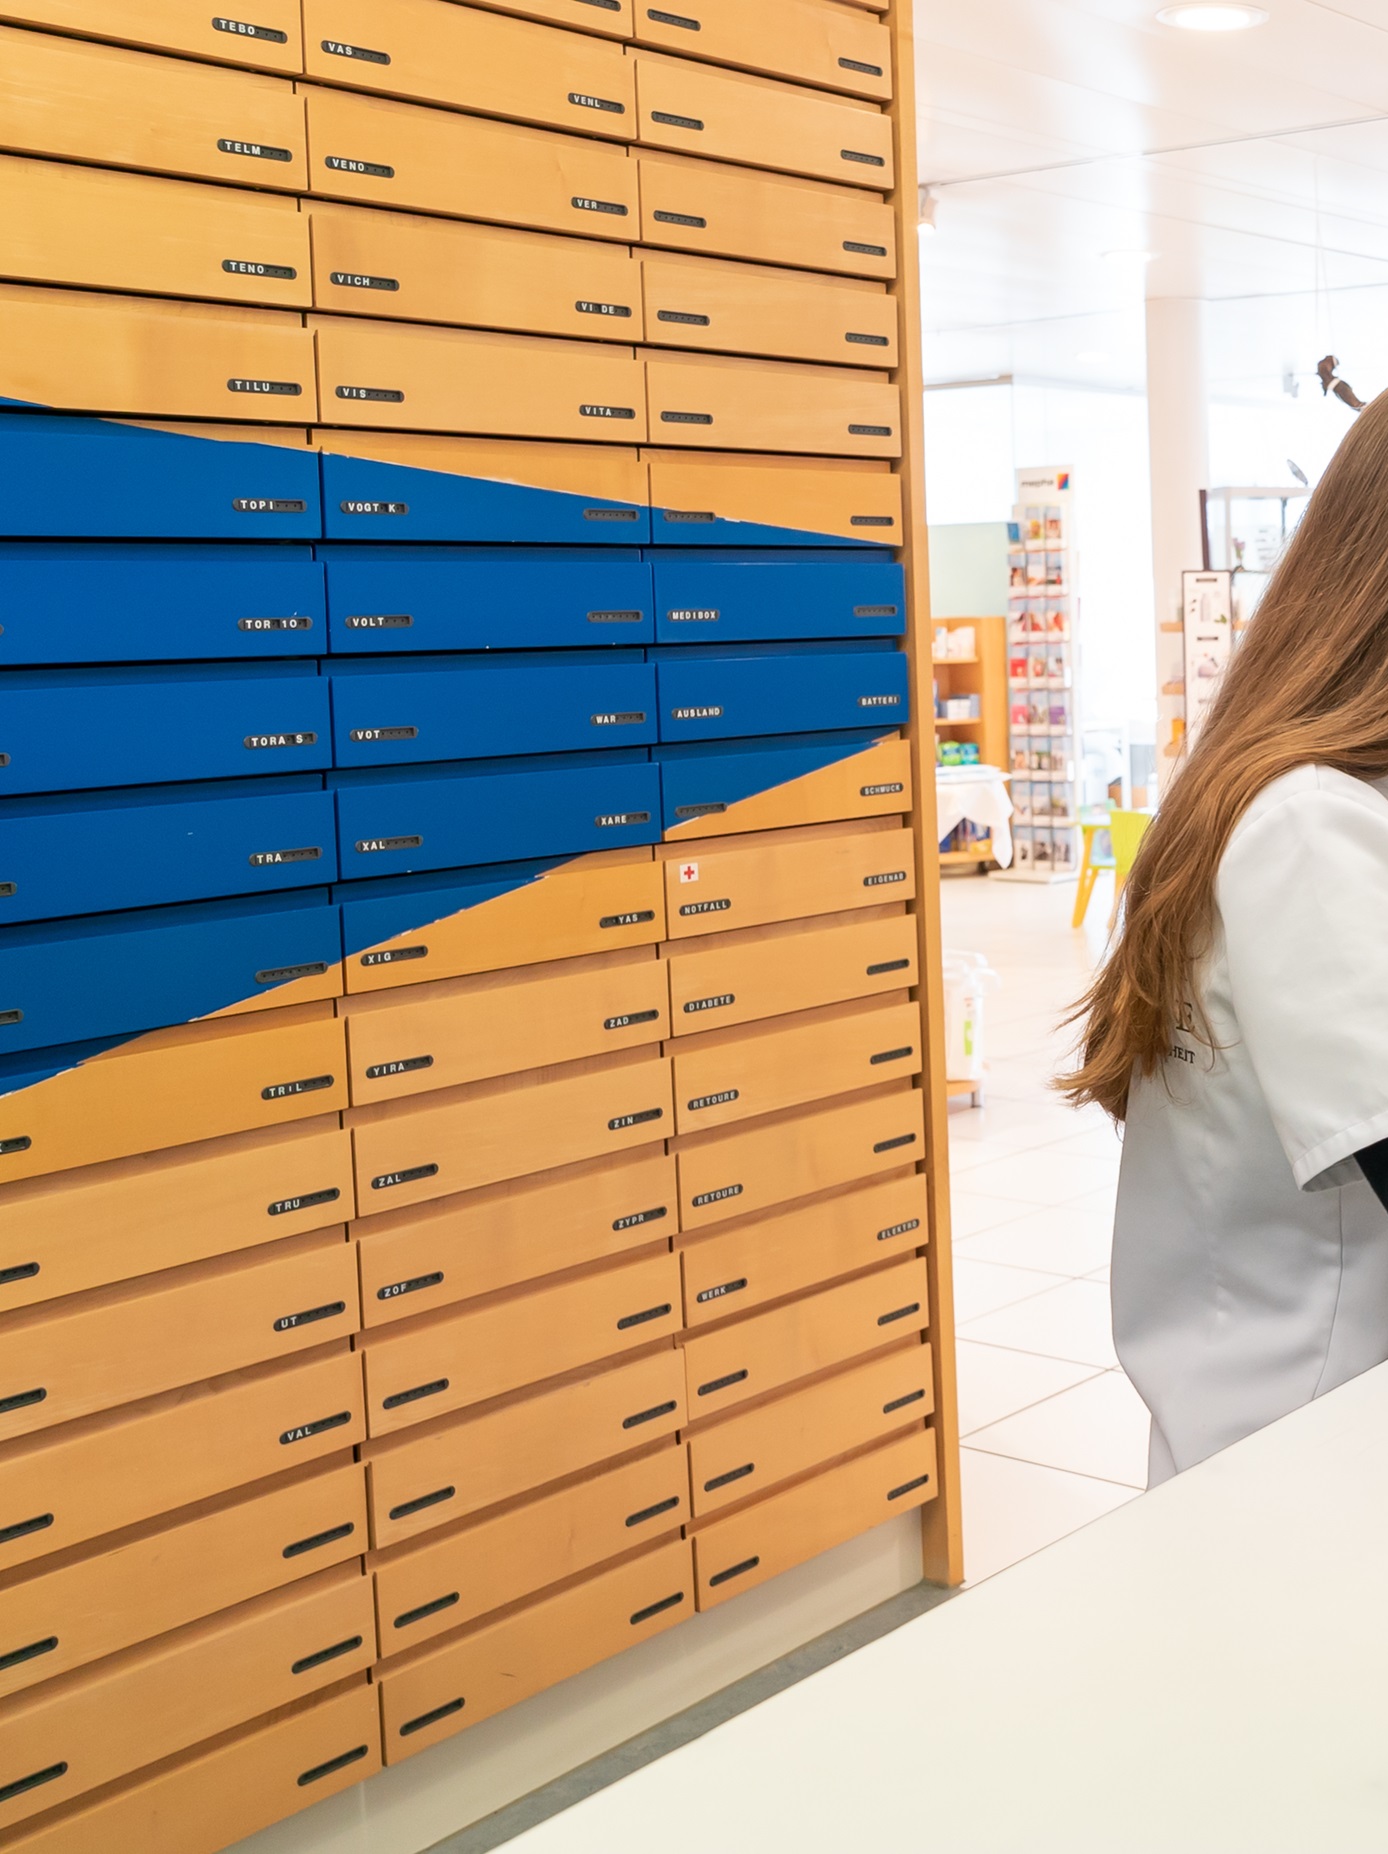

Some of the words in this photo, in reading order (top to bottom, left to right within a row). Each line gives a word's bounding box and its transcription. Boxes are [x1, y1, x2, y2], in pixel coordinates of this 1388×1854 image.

[219, 19, 256, 36] TEBO
[327, 42, 353, 56] VAS
[573, 94, 601, 108] VENL
[224, 141, 261, 156] TELM
[332, 158, 365, 172] VENO
[577, 198, 598, 210] VER
[229, 261, 265, 274] TENO
[337, 274, 370, 286] VICH
[581, 302, 593, 312] VI
[601, 304, 615, 314] DE
[234, 380, 270, 392] TILU
[342, 387, 367, 399] VIS
[585, 406, 612, 416] VITA
[239, 499, 274, 510] TOPI
[347, 502, 380, 513] VOGT
[388, 503, 396, 513] K
[672, 610, 716, 620] MEDIBOX
[245, 619, 271, 630] TOR
[352, 616, 385, 627] VOLT
[861, 696, 897, 706] BATTERI
[677, 707, 720, 718] AUSLAND
[595, 714, 616, 724] WAR
[251, 735, 286, 747] TORA
[295, 734, 304, 744] S
[356, 729, 380, 740] VOT
[864, 784, 900, 795] SCHMUCK
[601, 814, 627, 826] XARE
[362, 840, 386, 851] XAL
[256, 852, 282, 864] TRA
[684, 901, 727, 914] NOTFALL
[618, 914, 638, 924] YAS
[368, 952, 392, 964] XIG
[688, 995, 730, 1011] DIABETE
[609, 1016, 629, 1028] ZAD
[373, 1062, 405, 1076] YIRA
[693, 1091, 735, 1108] RETOURE
[614, 1116, 633, 1128] ZIN
[378, 1174, 401, 1187] ZAL
[697, 1186, 739, 1205] RETOURE
[275, 1199, 300, 1212] TRU
[618, 1214, 644, 1229] ZYPR
[881, 1221, 917, 1238] ELEKTRO
[384, 1283, 406, 1298] ZOF
[701, 1286, 726, 1301] WERK
[281, 1316, 297, 1328] UT
[287, 1426, 311, 1441] VAL
